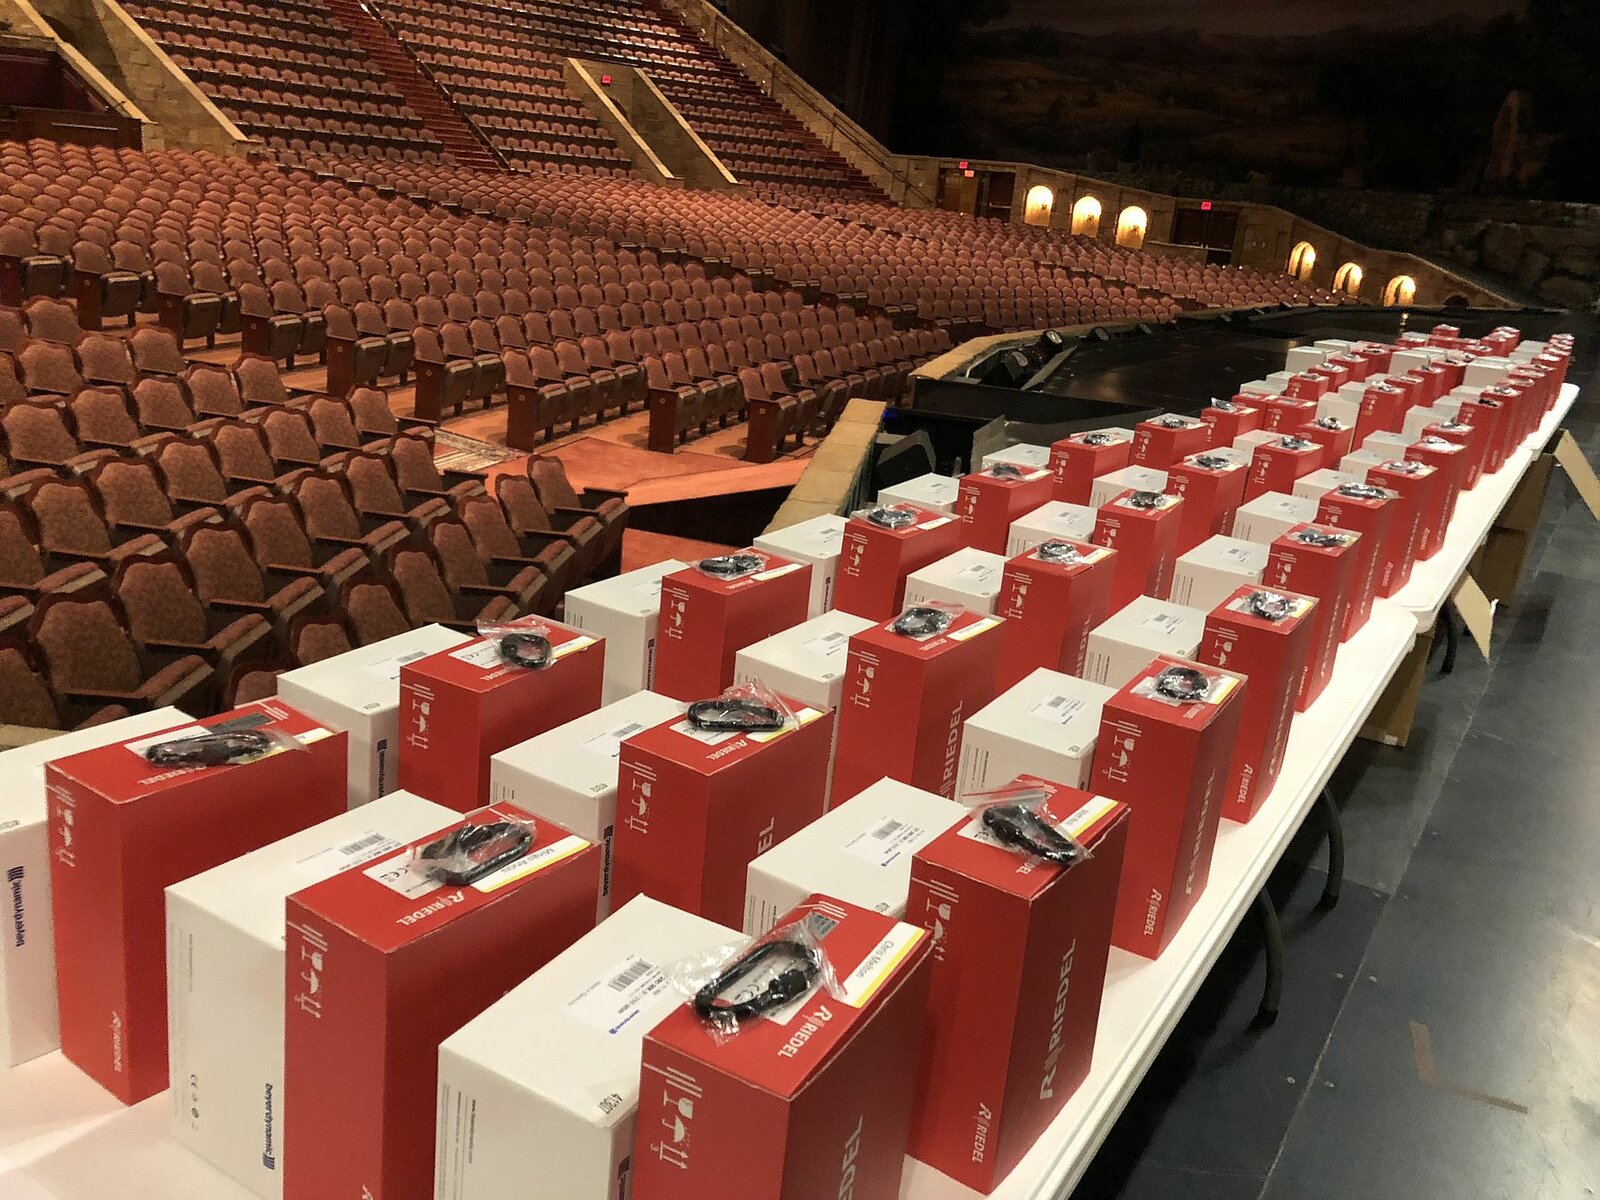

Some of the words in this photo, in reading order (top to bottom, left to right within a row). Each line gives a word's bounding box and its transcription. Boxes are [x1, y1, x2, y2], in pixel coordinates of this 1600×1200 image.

[396, 901, 446, 926] RIEDEL
[1048, 937, 1077, 1050] RIEDEL
[777, 1020, 818, 1058] RIEDEL
[263, 1083, 274, 1155] beyerdynamic
[972, 1124, 988, 1164] RIEDEL
